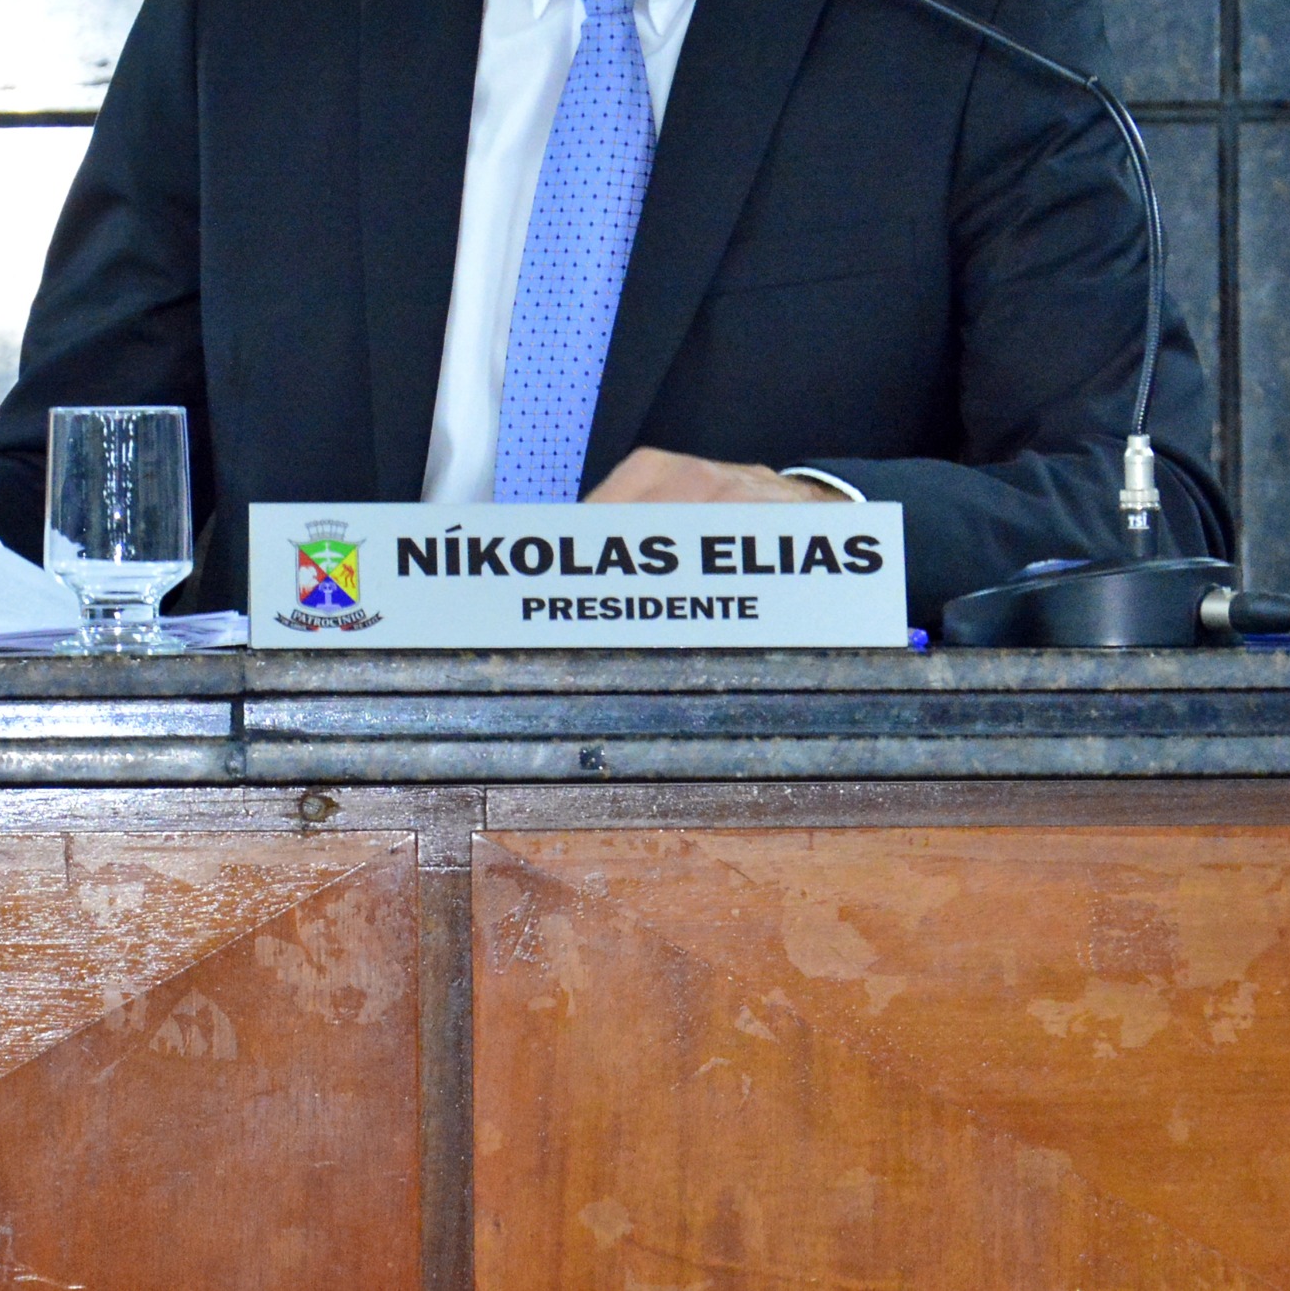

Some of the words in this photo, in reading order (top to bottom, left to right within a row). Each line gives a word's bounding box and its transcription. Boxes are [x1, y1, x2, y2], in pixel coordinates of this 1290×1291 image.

[396, 524, 680, 578] NÍKOLAS
[699, 534, 884, 575] ELIAS
[521, 596, 759, 621] PRESIDENTE
